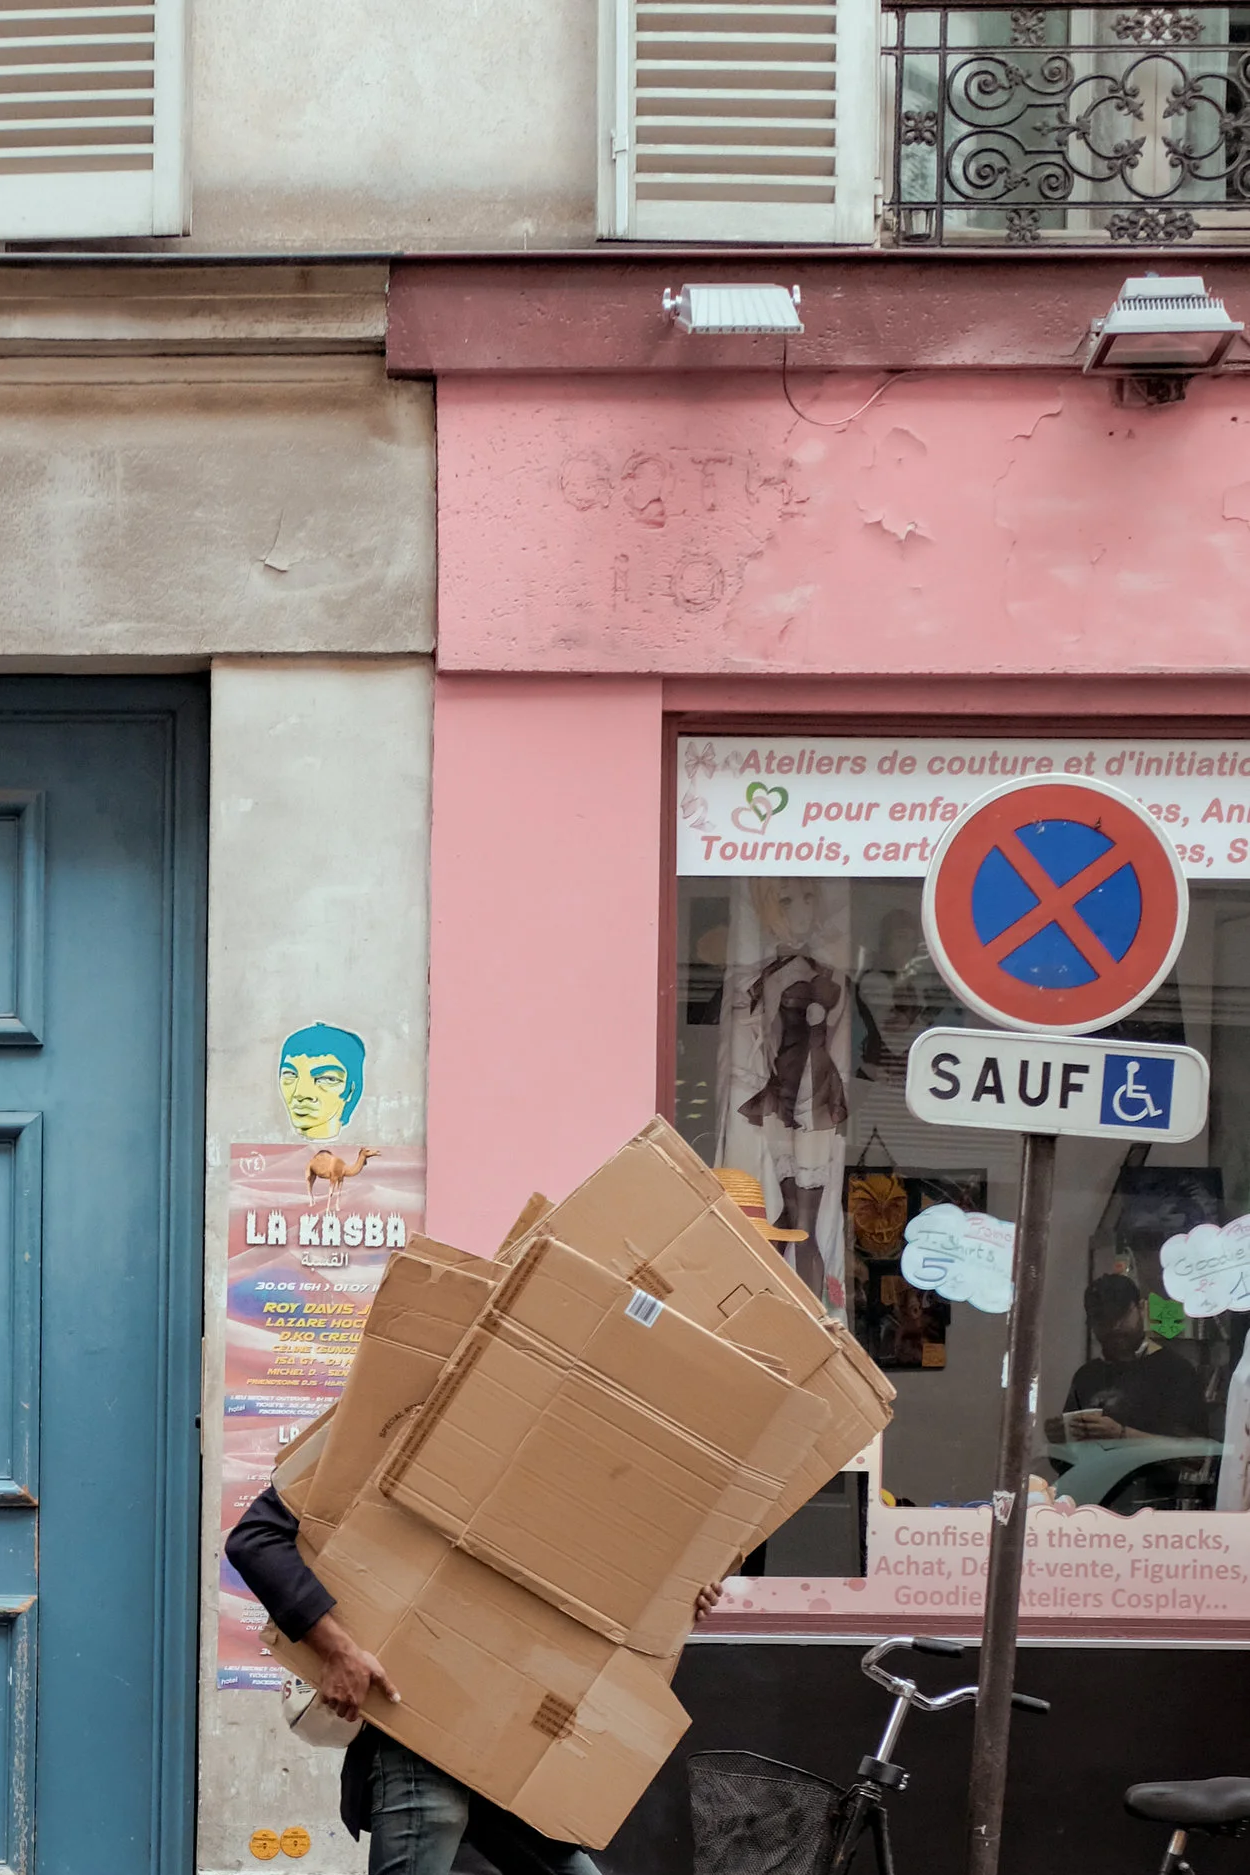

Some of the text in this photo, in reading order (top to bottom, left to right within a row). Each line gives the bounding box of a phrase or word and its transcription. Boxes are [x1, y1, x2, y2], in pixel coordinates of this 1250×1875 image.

[740, 749, 868, 775] Ateliers
[877, 750, 917, 775] de
[927, 750, 1054, 776] couture
[1064, 751, 1096, 776] et
[802, 801, 880, 828] pour
[1138, 798, 1190, 828] es,
[1201, 797, 1250, 824] An
[700, 835, 850, 866] Tournois,
[1173, 843, 1214, 868] es,
[928, 1052, 1091, 1109] SAUF
[246, 1209, 407, 1248] LA KASBA
[254, 1281, 297, 1292] 30.06
[262, 1301, 371, 1316] ROY DAVIS J
[265, 1317, 328, 1329] LAZARE
[315, 1345, 358, 1355] (SUNDA
[1025, 1526, 1038, 1548] à
[1047, 1526, 1134, 1553] thème,
[1142, 1528, 1230, 1554] snacks,
[874, 1554, 1249, 1584] Achat, Dét-vente, Figurines,
[894, 1584, 983, 1607] Goodie
[1111, 1587, 1228, 1614] Cosplay...
